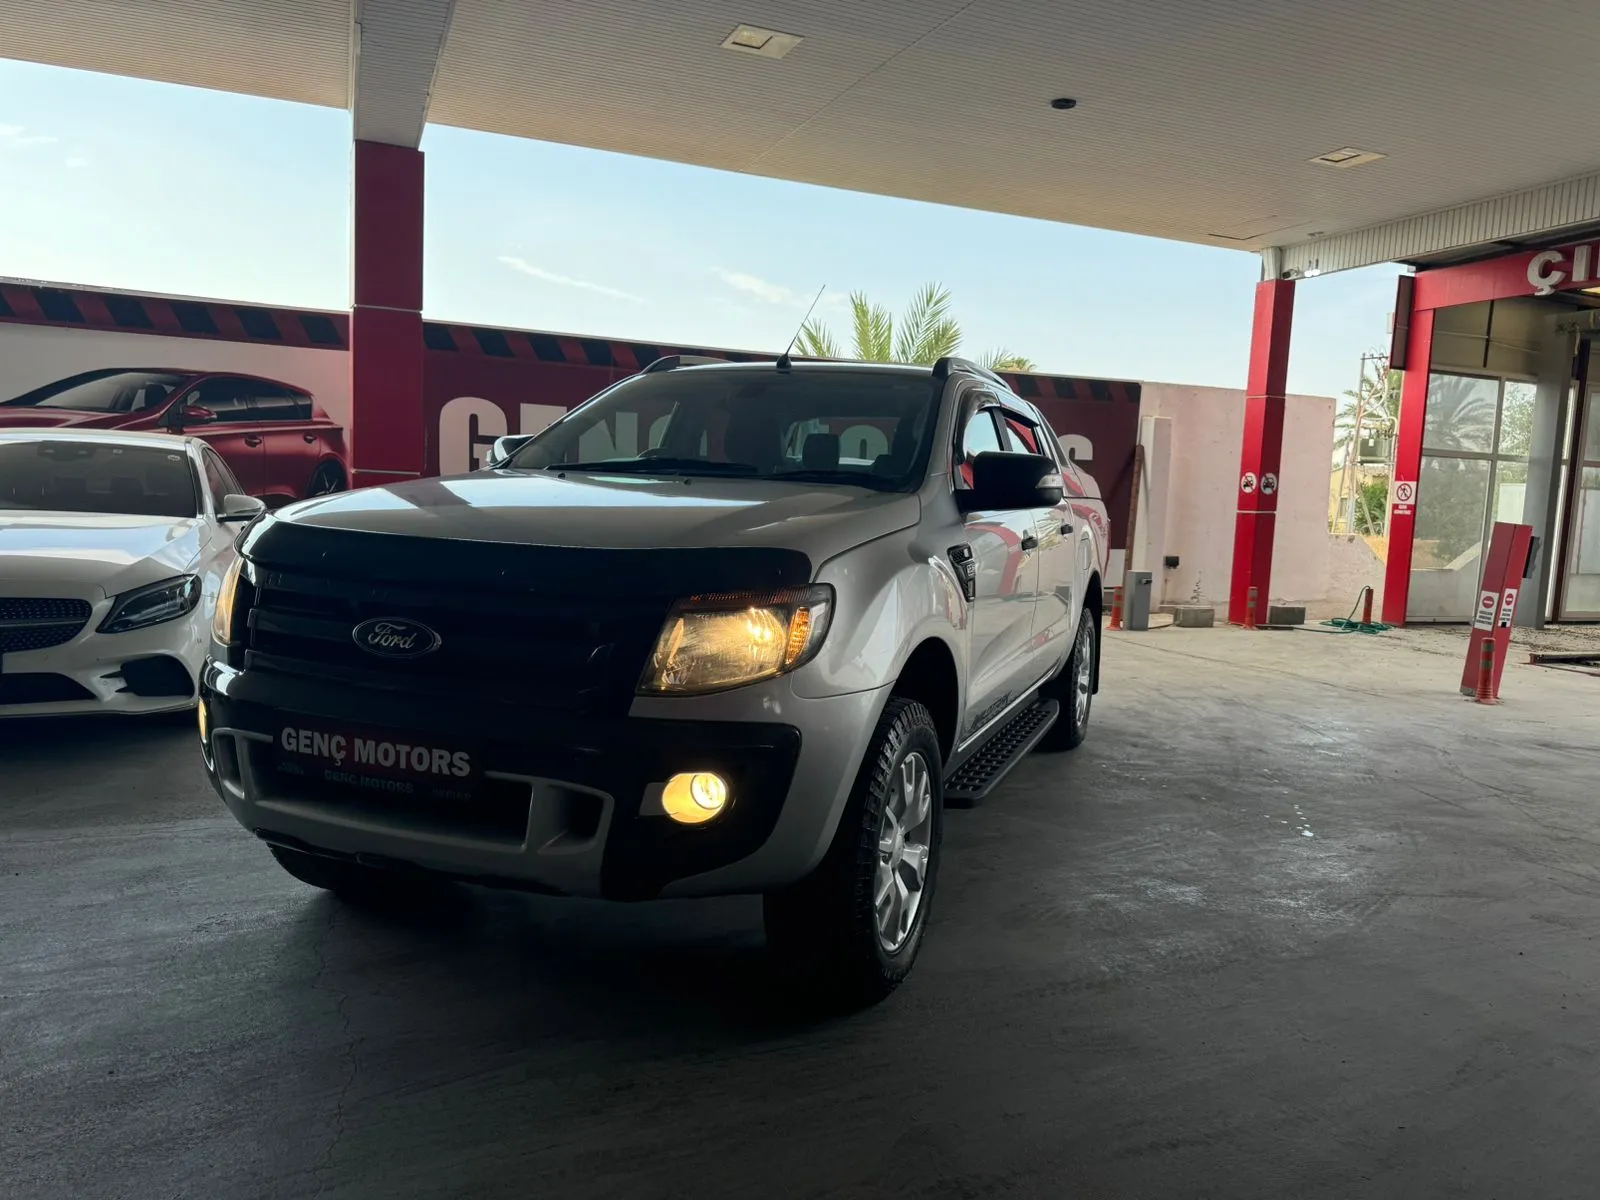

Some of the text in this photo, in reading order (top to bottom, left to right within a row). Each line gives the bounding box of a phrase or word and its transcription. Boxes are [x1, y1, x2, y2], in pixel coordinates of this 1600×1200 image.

[1527, 245, 1600, 296] ÇI
[368, 622, 418, 649] Ford
[281, 727, 472, 778] GENÇ MOTORS
